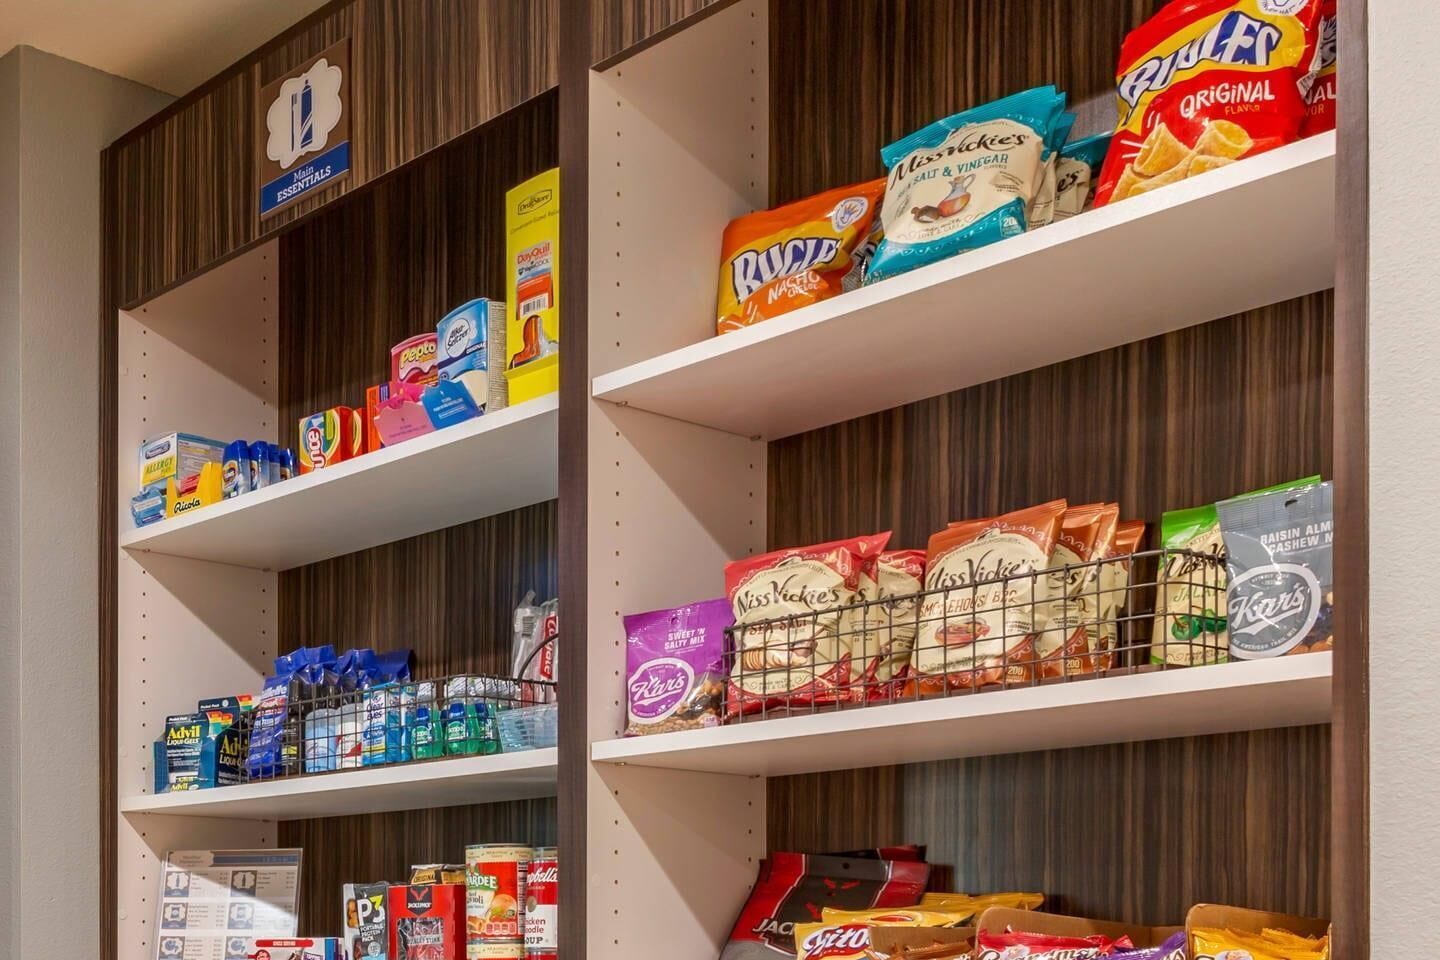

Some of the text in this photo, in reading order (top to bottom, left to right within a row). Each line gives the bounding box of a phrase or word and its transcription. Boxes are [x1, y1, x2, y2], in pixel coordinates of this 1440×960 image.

[1180, 80, 1276, 118] ORIGINAL
[890, 131, 1026, 190] Miss Vickie's
[913, 154, 1008, 185] SALT & VINEGAR
[277, 166, 331, 202] ESSENTIALS
[293, 165, 314, 183] Main
[518, 242, 550, 264] DayQuil
[768, 272, 820, 305] NACHO
[146, 456, 174, 474] ALLERGY
[174, 497, 200, 514] Ricola
[1261, 520, 1334, 544] RAISIN ALM
[1268, 536, 1319, 553] CASHEW
[770, 574, 840, 610] Vickie's
[1230, 583, 1306, 630] Kar's
[664, 636, 705, 649] SALTY MIX
[668, 630, 694, 640] SWEET
[631, 671, 685, 701] Kar's
[168, 725, 201, 739] Advil
[467, 874, 497, 889] ARDEE
[527, 868, 558, 885] pbell's
[358, 895, 385, 926] P3
[753, 919, 795, 935] JAC
